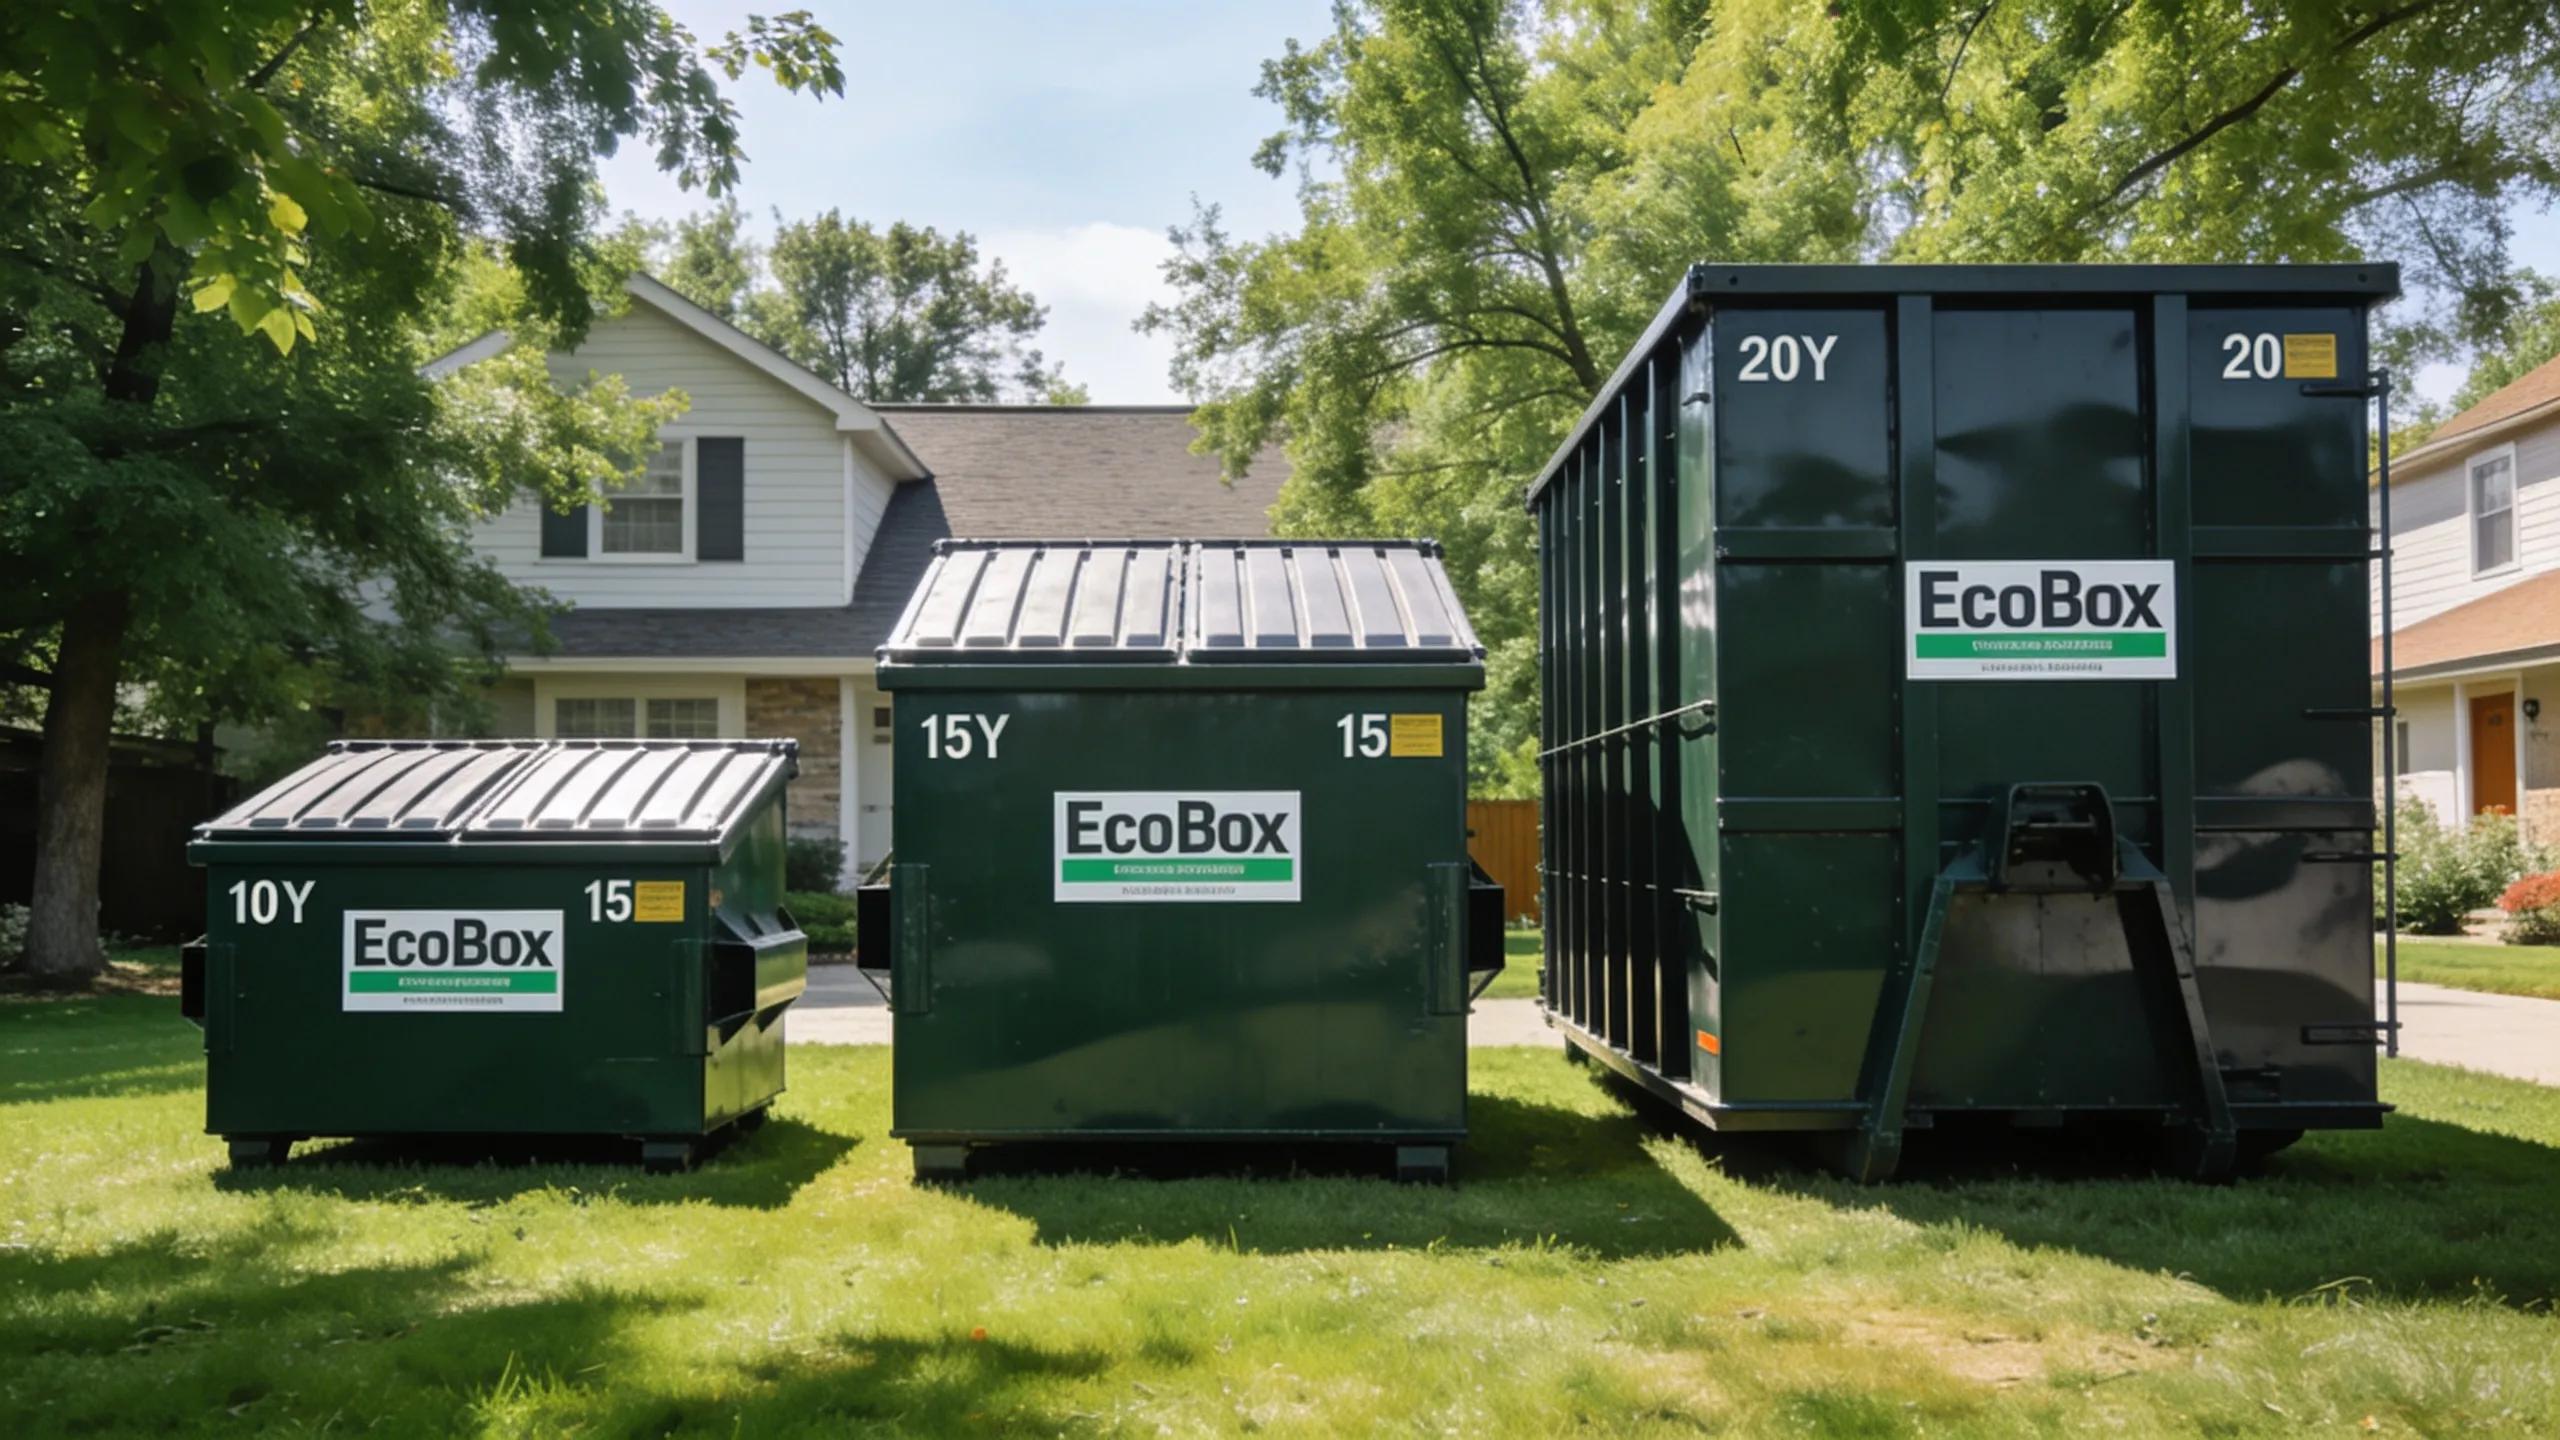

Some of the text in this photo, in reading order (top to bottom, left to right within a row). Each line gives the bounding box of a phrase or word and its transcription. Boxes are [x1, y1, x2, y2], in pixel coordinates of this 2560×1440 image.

[1738, 334, 1838, 381] 20Y
[2222, 332, 2282, 379] 20
[1919, 570, 2163, 628] EcoBox
[921, 714, 1010, 759] 15Y
[1337, 713, 1388, 758] 15
[1066, 800, 1289, 854] EcoBox
[229, 880, 316, 924] 10Y
[584, 879, 632, 922] 15
[354, 918, 553, 967] EcoBox
